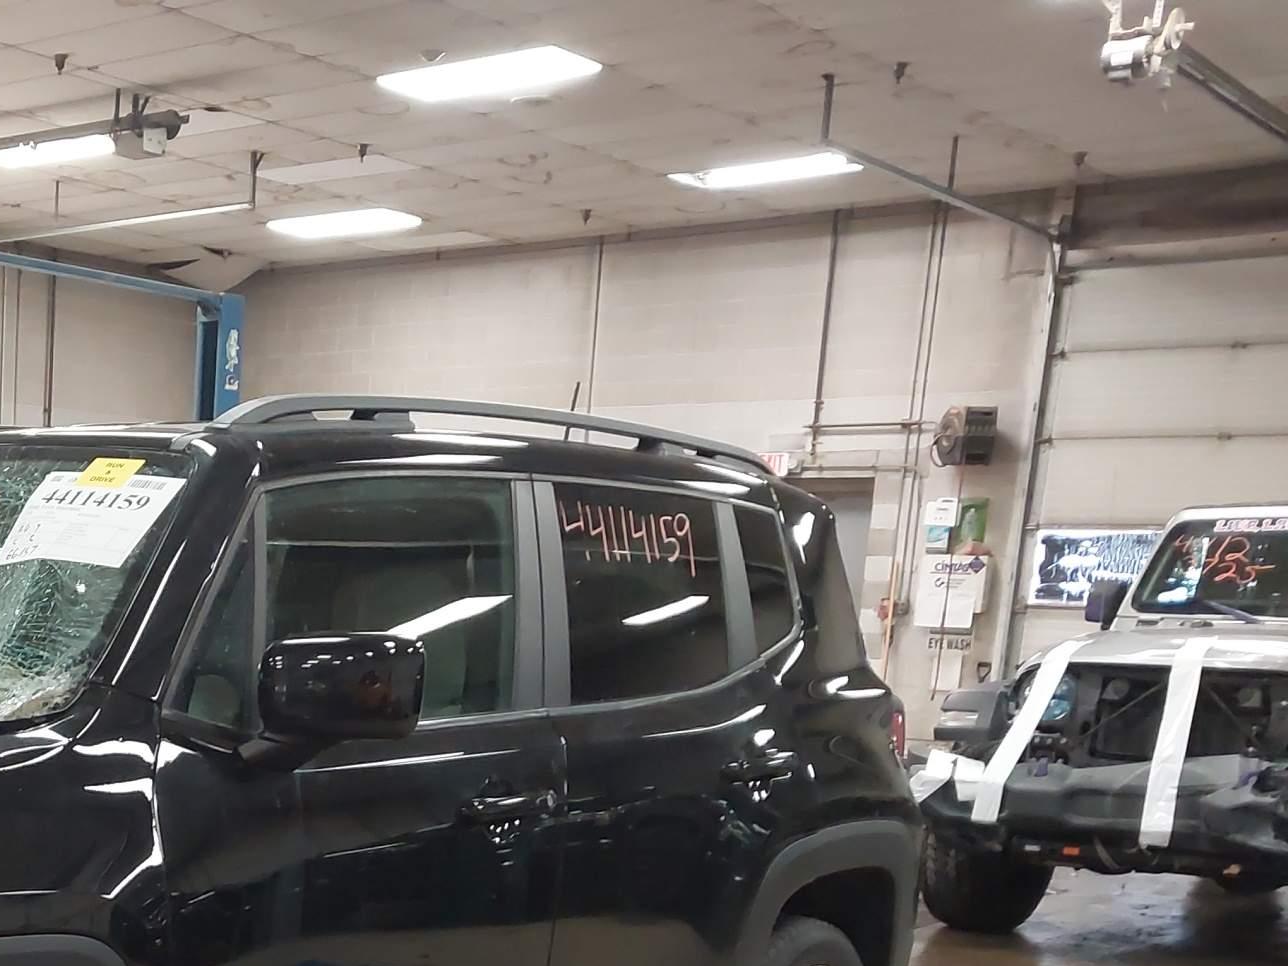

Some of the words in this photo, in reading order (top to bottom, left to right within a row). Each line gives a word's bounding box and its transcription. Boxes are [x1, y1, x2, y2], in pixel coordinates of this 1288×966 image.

[41, 488, 151, 511] 44114159
[559, 501, 696, 578] 44114159
[947, 638, 972, 651] WASH
